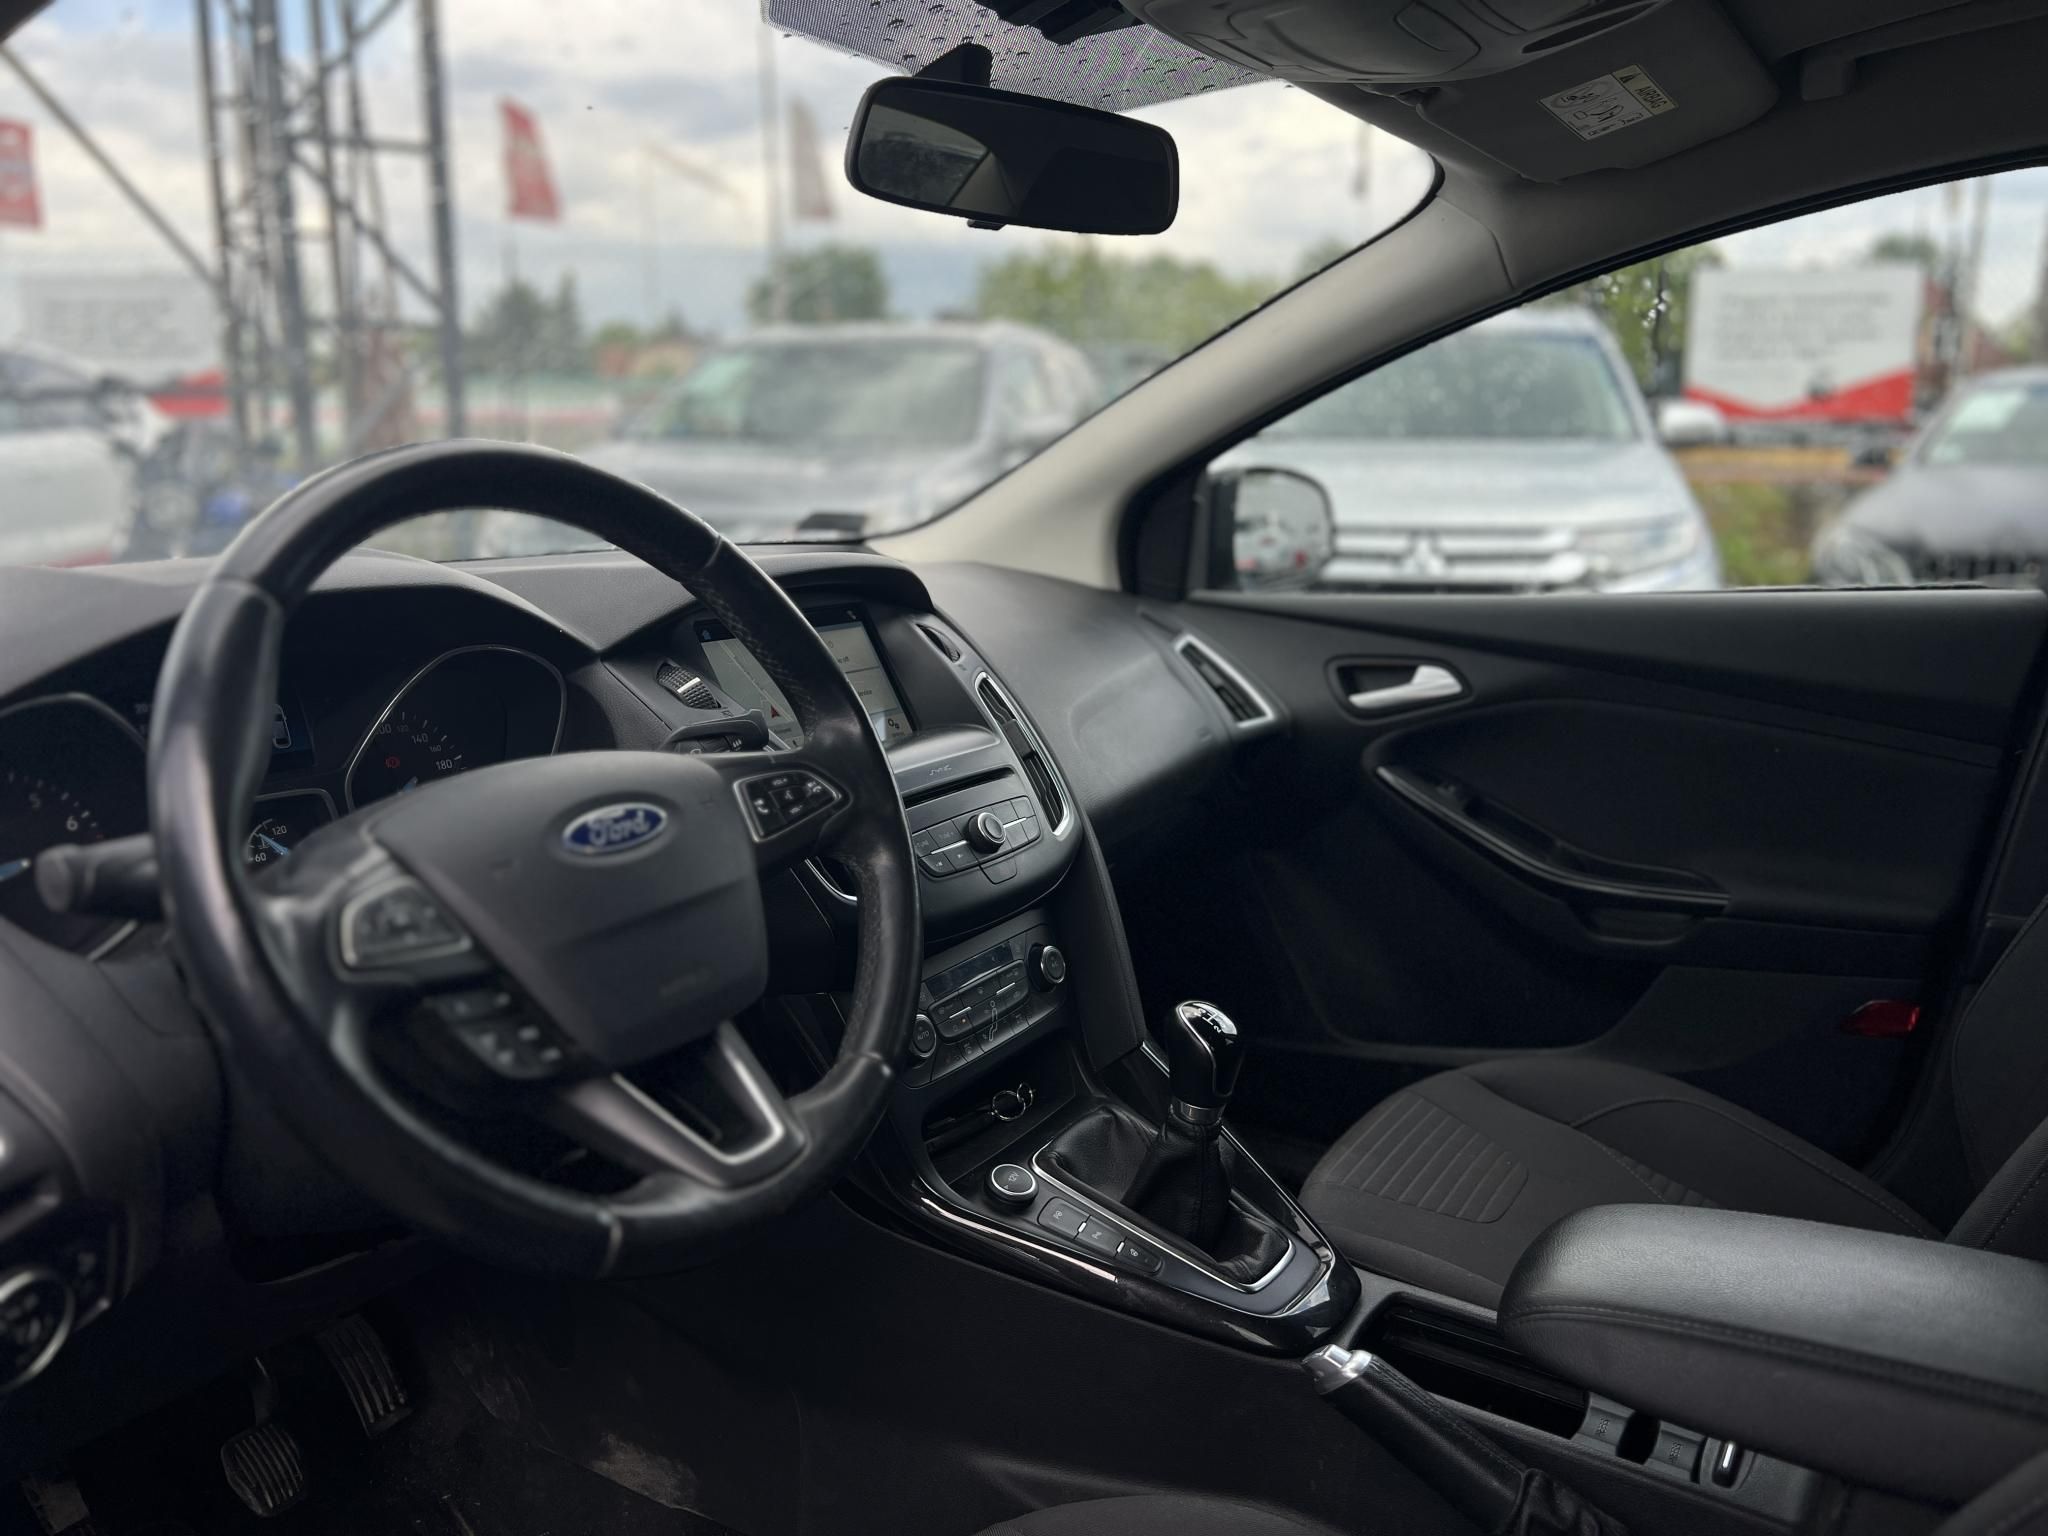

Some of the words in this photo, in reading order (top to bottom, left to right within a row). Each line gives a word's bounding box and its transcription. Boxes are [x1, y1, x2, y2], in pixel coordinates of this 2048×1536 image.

[1634, 86, 1667, 109] AIRBAG
[411, 733, 429, 744] 140
[429, 744, 442, 753] 160
[435, 759, 453, 771] 180
[65, 815, 78, 831] 6
[587, 810, 651, 846] Ford
[271, 825, 287, 836] 120
[254, 852, 266, 862] 60
[1213, 1025, 1221, 1033] 2
[917, 1030, 929, 1041] AUTO
